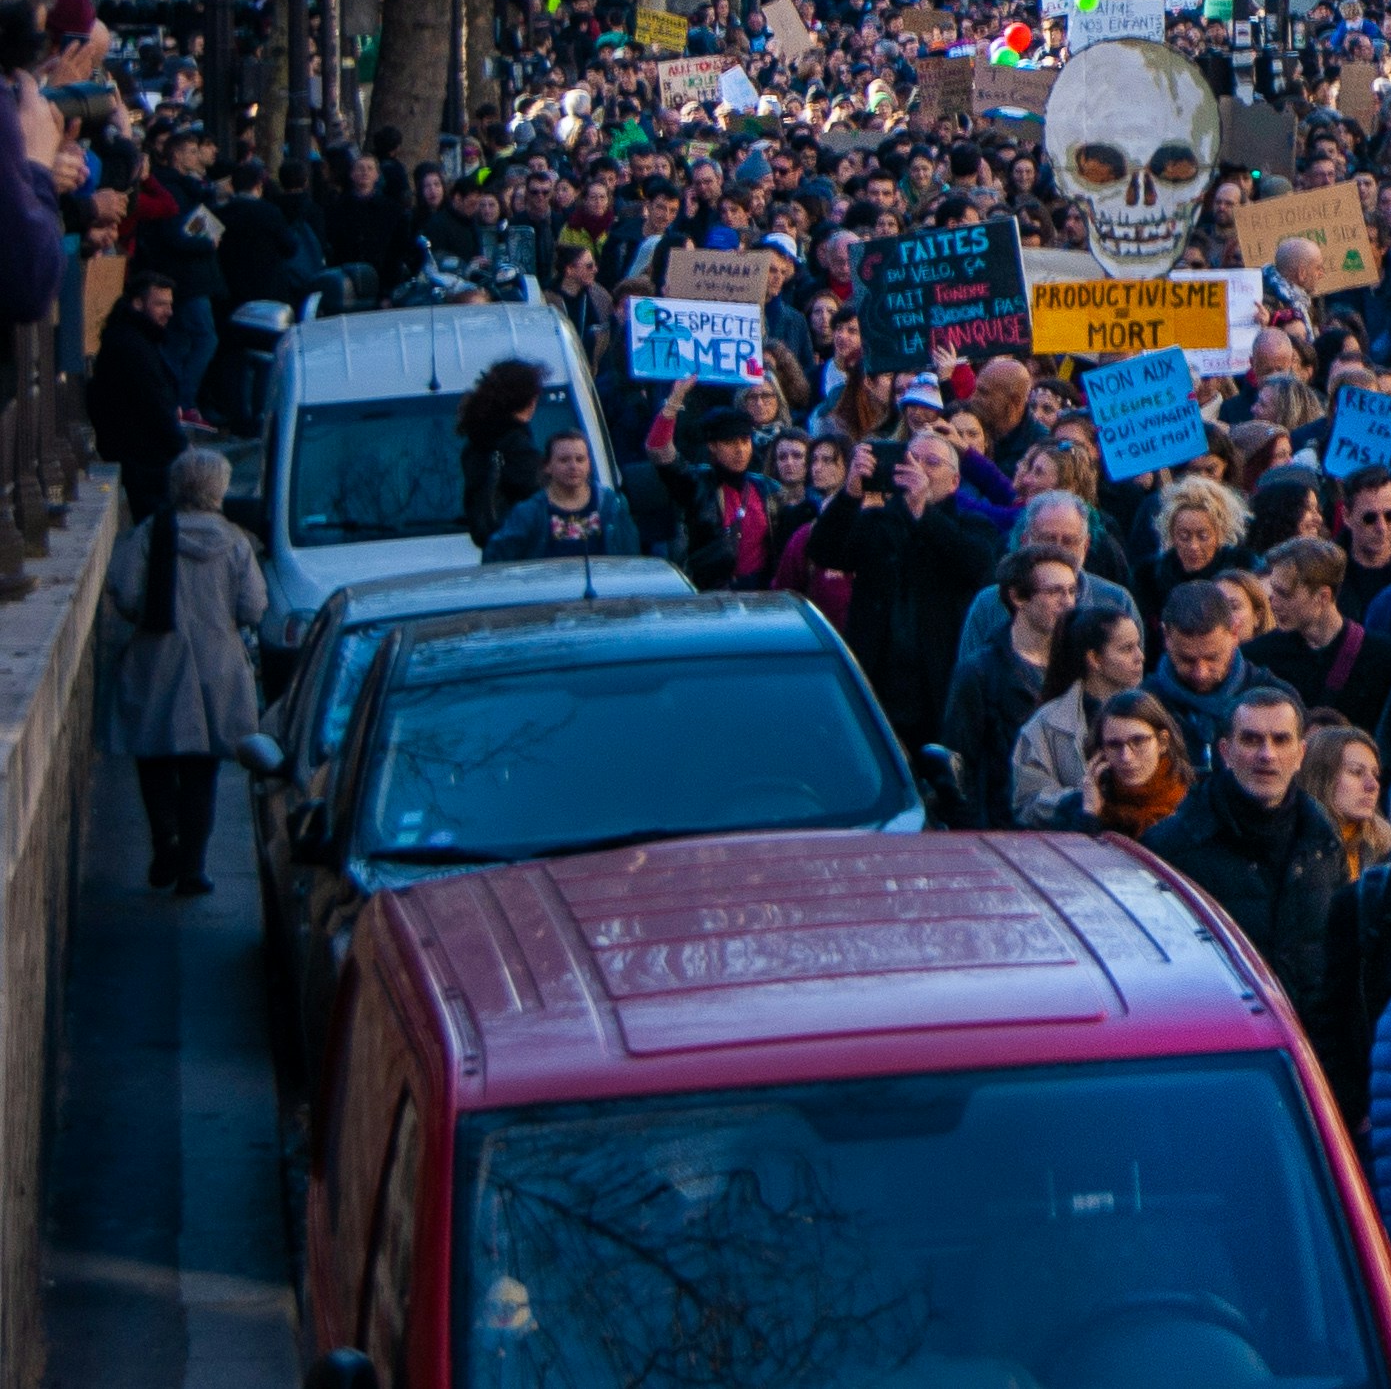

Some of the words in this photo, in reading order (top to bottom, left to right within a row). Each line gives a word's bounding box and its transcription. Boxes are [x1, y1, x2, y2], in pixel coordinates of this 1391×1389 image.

[899, 226, 990, 265] FAITES
[886, 267, 906, 284] DU
[886, 287, 924, 310] FAIT
[1034, 281, 1222, 310] PRODUCTIVISME
[655, 307, 760, 341] RESPECTE
[892, 313, 925, 329] TON
[902, 330, 926, 355] LA
[930, 313, 1030, 349] BANQUISE
[1087, 319, 1166, 349] MORT
[651, 340, 681, 371] TA
[694, 338, 756, 374] MER
[1089, 368, 1136, 401] NON
[1142, 356, 1178, 384] AUX
[1102, 423, 1137, 443] QUI
[1127, 437, 1159, 458] QUE
